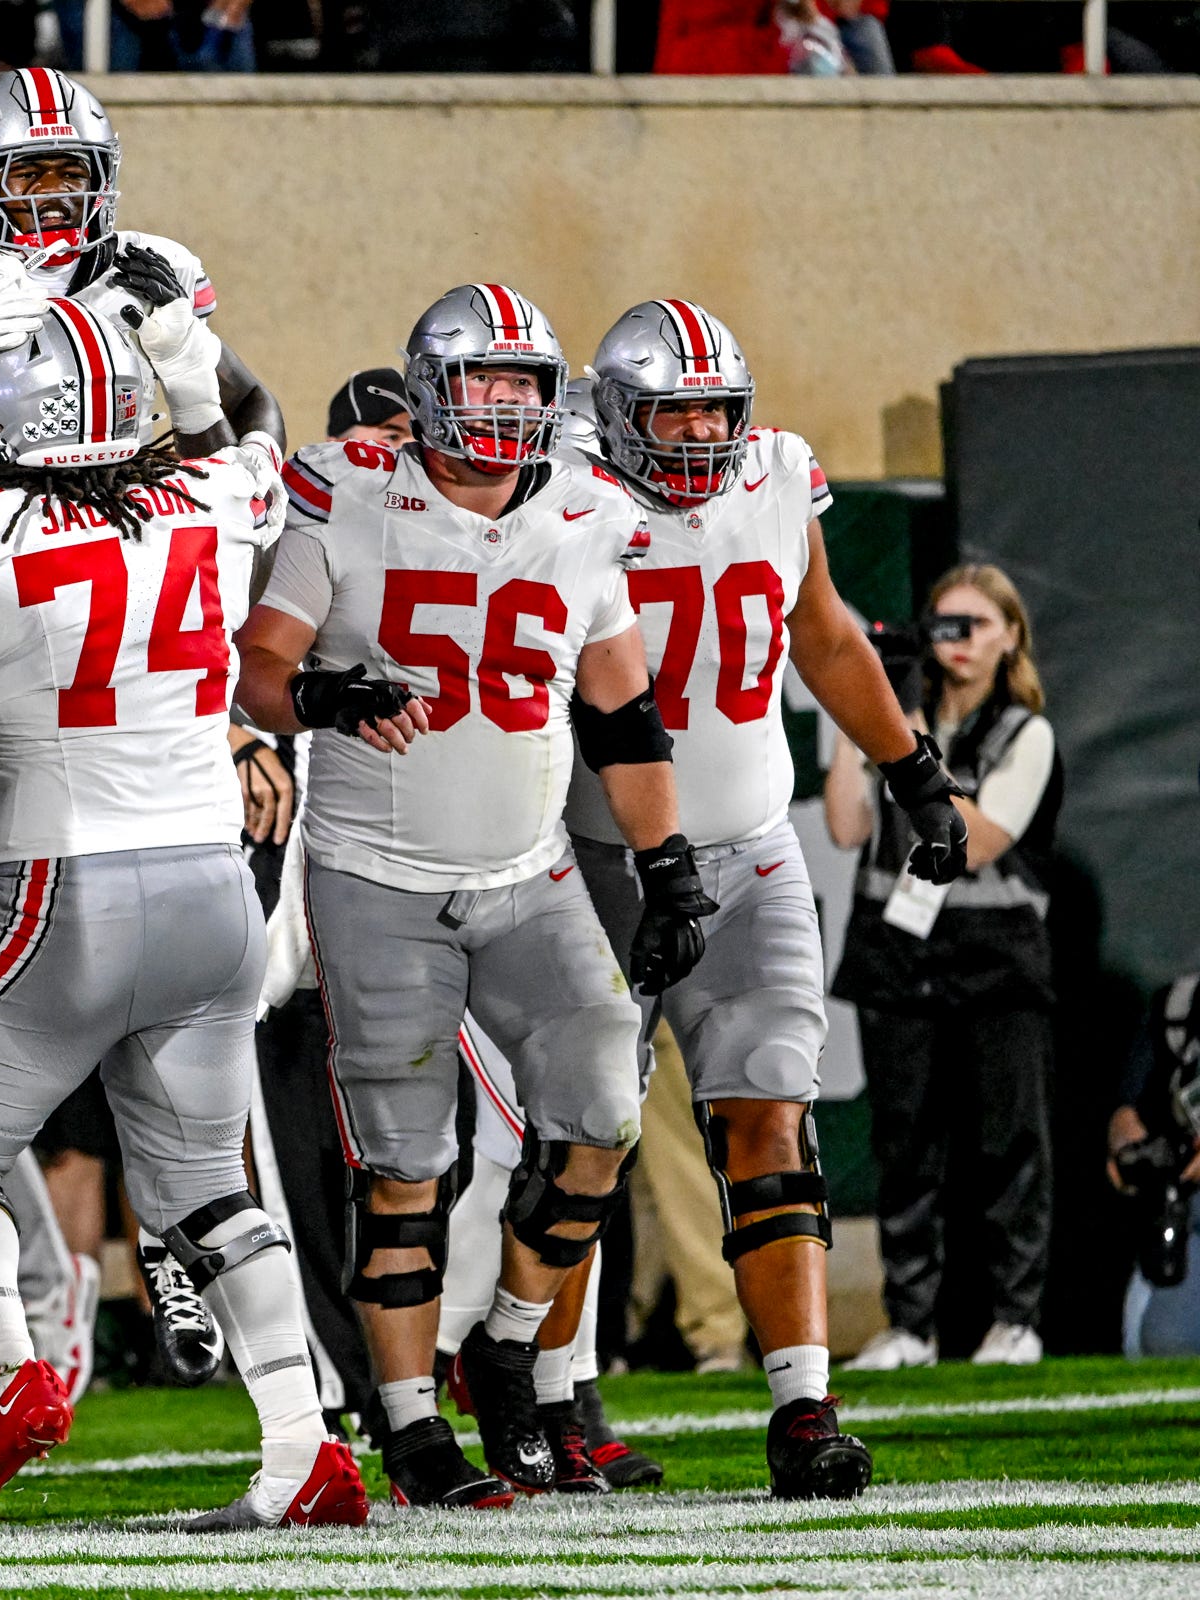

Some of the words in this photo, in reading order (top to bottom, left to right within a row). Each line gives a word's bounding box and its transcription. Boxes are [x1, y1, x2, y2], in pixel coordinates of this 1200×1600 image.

[29, 126, 49, 138] OHIO
[50, 125, 73, 136] STATE
[683, 376, 701, 387] OHIO
[703, 376, 723, 387] STATE
[116, 393, 126, 405] 74
[43, 449, 135, 465] BUCKEYES
[12, 526, 230, 728] 74
[377, 568, 568, 733] 56
[627, 560, 785, 731] 70
